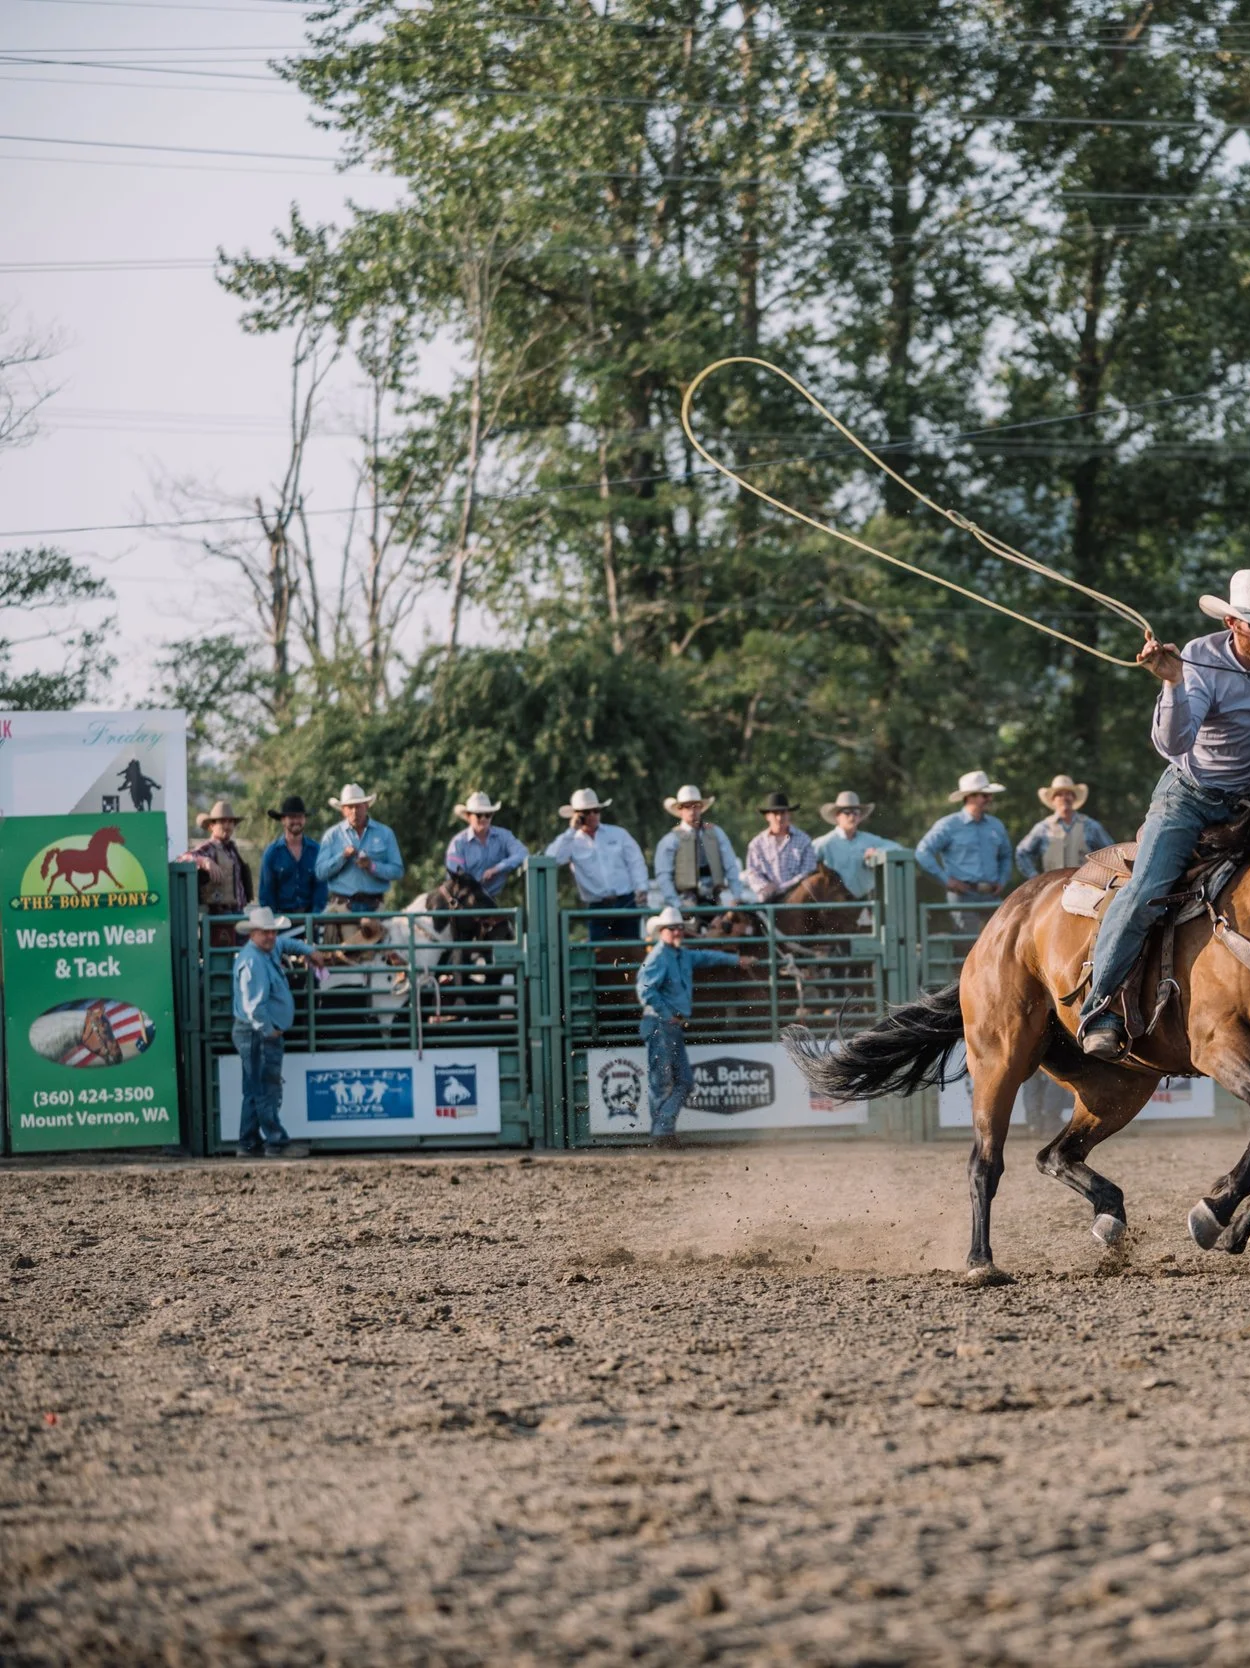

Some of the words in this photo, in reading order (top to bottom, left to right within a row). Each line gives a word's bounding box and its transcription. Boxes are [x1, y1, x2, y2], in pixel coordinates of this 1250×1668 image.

[83, 720, 163, 750] Friday
[20, 895, 53, 910] THE
[60, 894, 101, 909] BONY
[108, 892, 149, 907] PONY
[16, 927, 100, 949] Western
[103, 925, 156, 946] Wear
[55, 958, 71, 979] &
[74, 956, 121, 977] Tack
[717, 1065, 768, 1082] Baker
[34, 1090, 74, 1107] (360)
[78, 1086, 154, 1104] 424-3500
[21, 1112, 73, 1128] Mount
[76, 1109, 139, 1127] Vernon,
[142, 1107, 169, 1122] WA
[336, 1104, 384, 1114] BOYS
